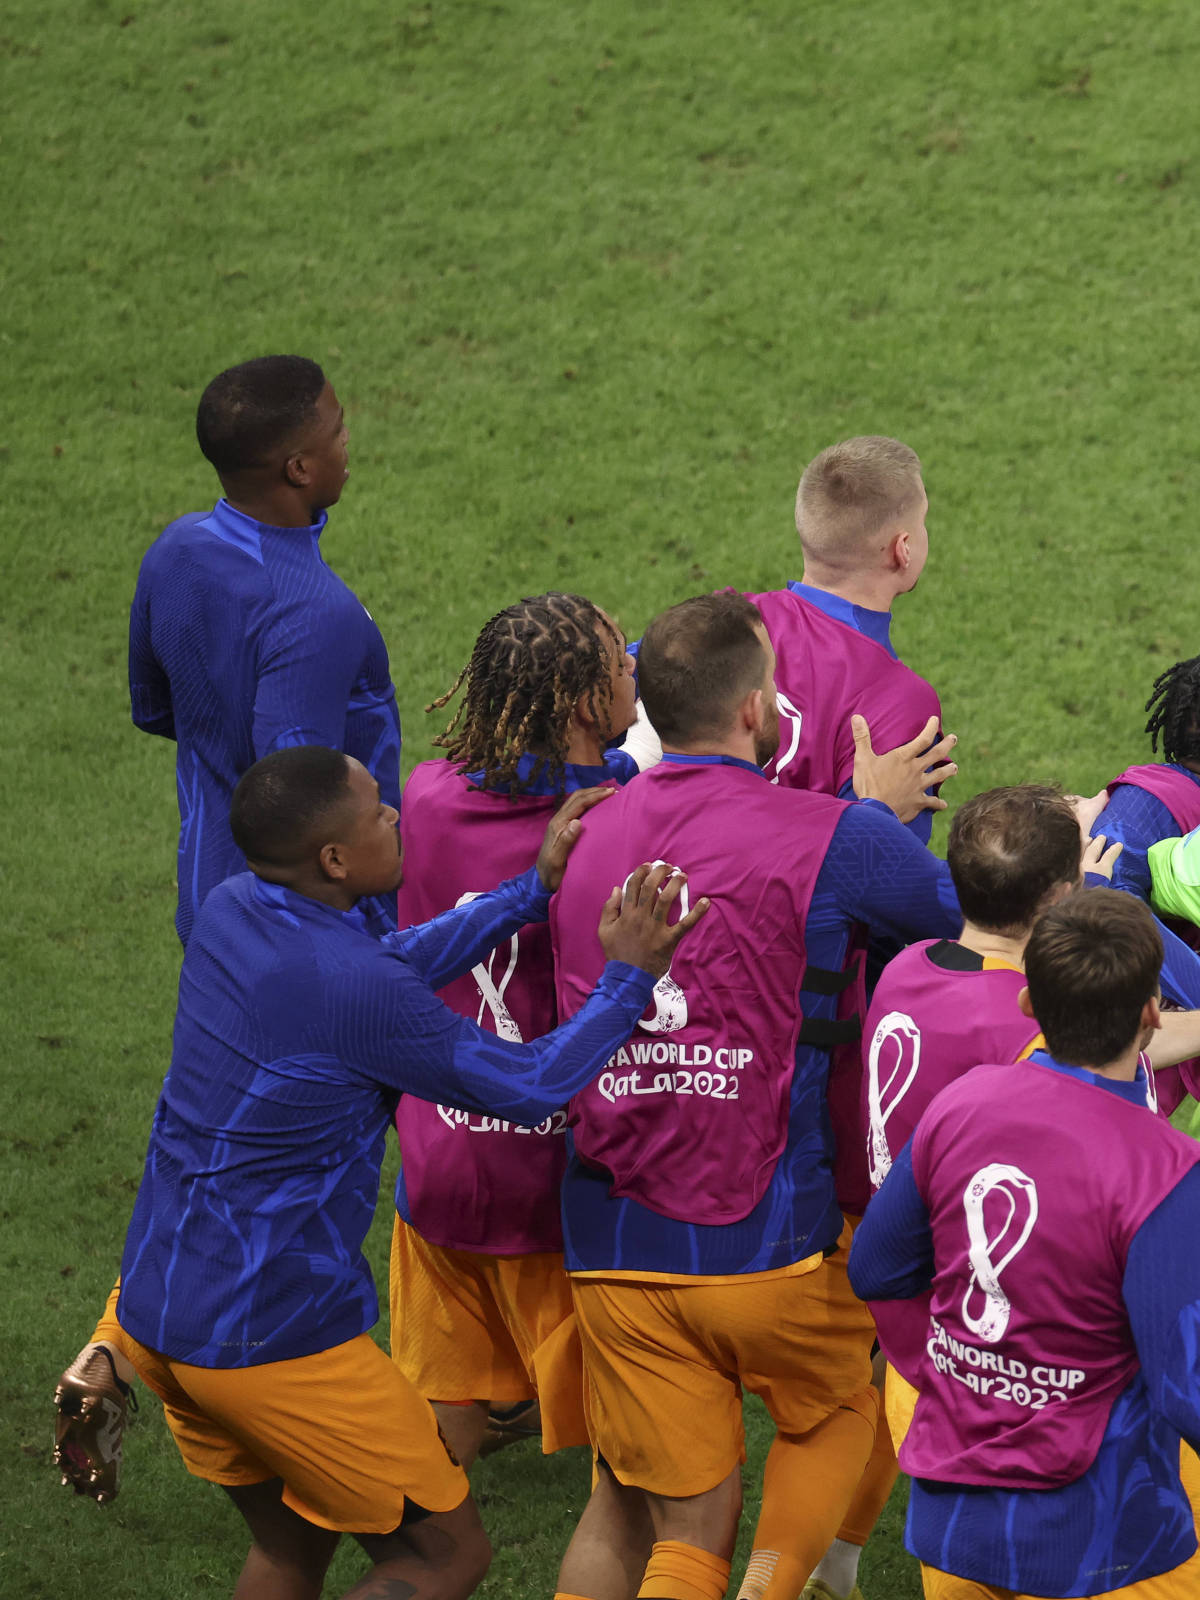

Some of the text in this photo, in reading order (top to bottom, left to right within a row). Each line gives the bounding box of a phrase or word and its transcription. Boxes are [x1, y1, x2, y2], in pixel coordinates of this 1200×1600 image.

[631, 1042, 713, 1066] WORLD
[714, 1047, 754, 1070] CUP
[947, 1334, 1028, 1379] WORLD
[1031, 1366, 1086, 1390] CUP
